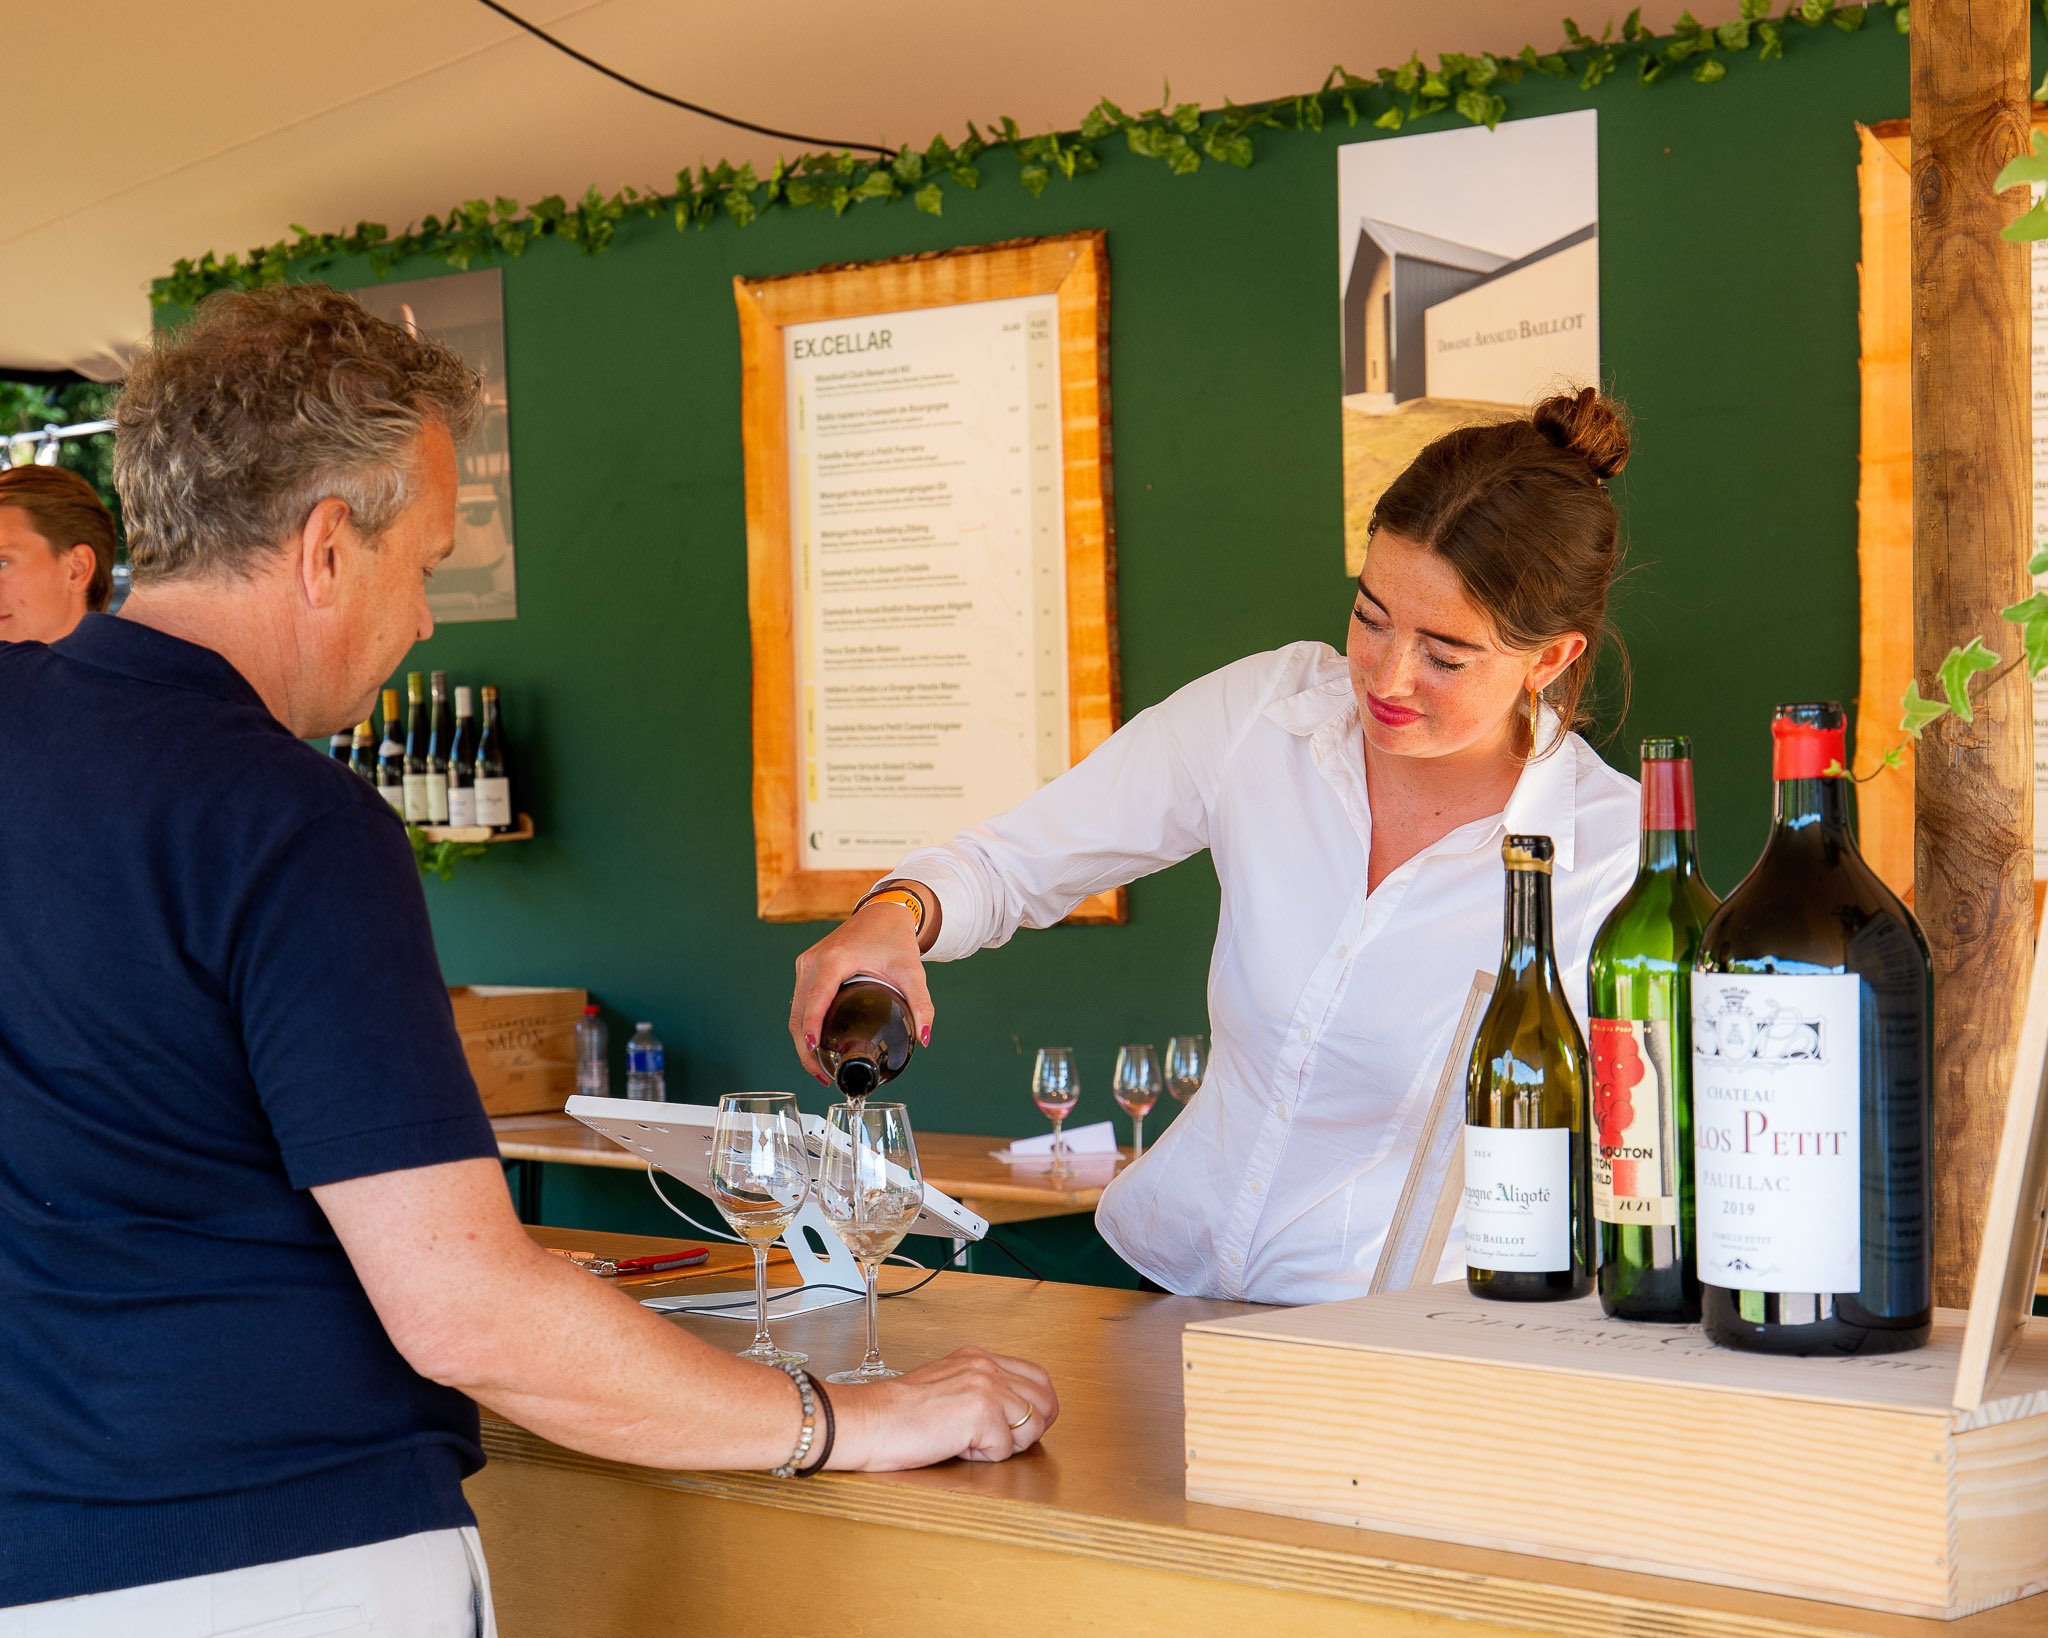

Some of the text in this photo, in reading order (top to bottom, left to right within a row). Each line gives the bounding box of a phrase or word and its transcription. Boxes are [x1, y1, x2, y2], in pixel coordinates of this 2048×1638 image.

[1519, 313, 1585, 339] BAILLOT
[793, 329, 892, 360] EX.CELLAR
[1705, 1085, 1776, 1103] CHATEAU
[1702, 1169, 1791, 1194] PAUILLAC
[1495, 1182, 1552, 1210] Aligoté
[1722, 1199, 1756, 1217] 2019
[1483, 1233, 1526, 1246] BAILLOT
